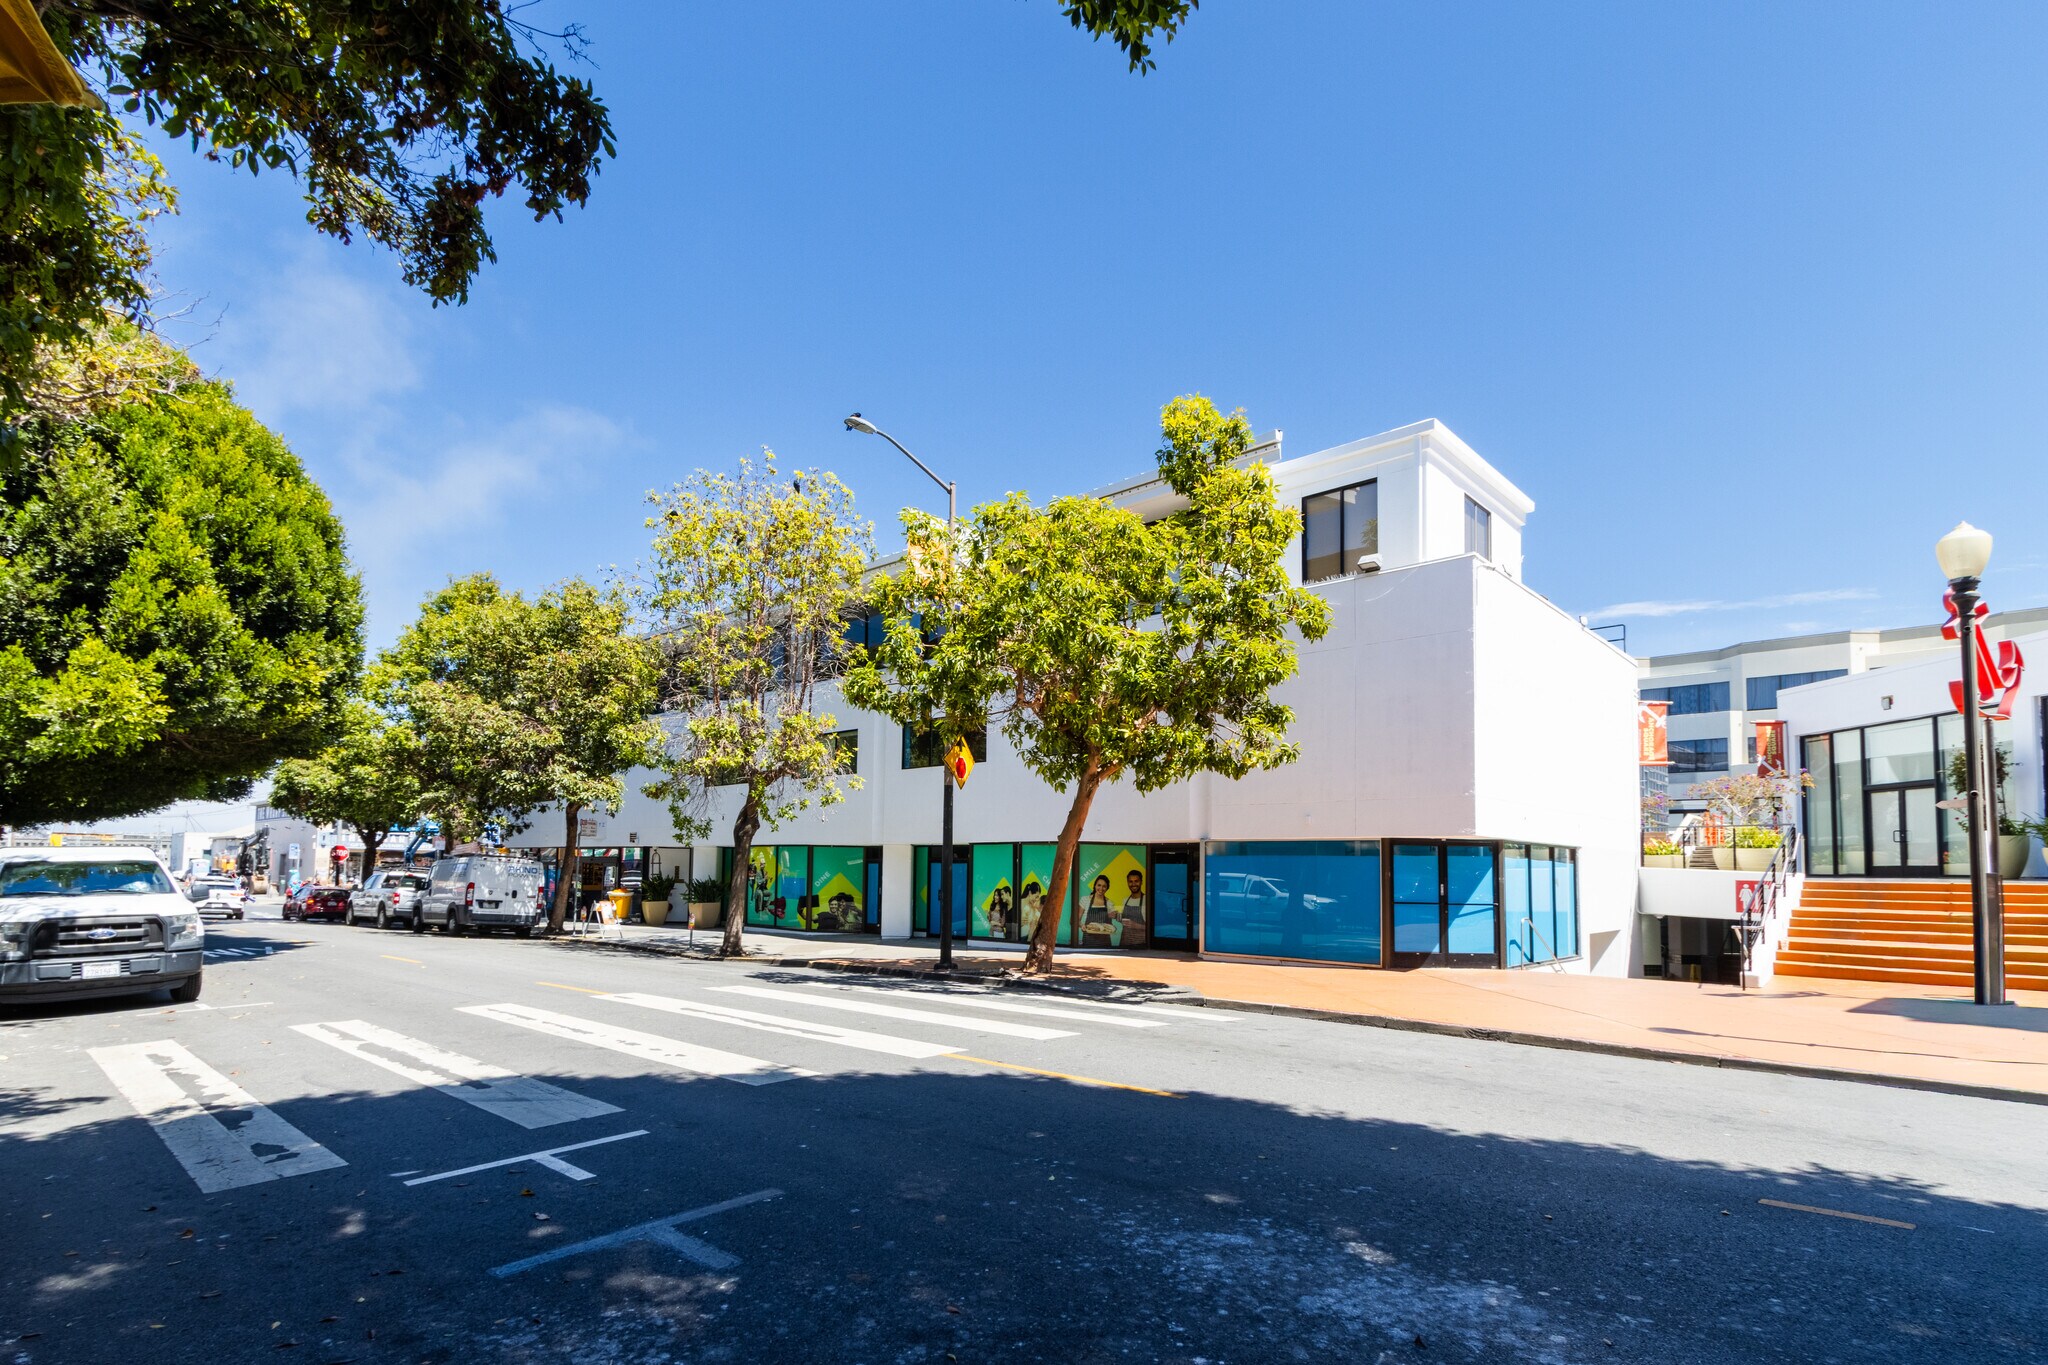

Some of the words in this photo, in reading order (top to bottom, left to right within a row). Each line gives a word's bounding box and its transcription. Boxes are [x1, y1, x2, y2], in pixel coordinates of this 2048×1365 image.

[331, 849, 348, 857] STOP
[508, 865, 538, 874] RHINO
[1080, 862, 1100, 882] SMILE
[815, 871, 831, 887] DINE
